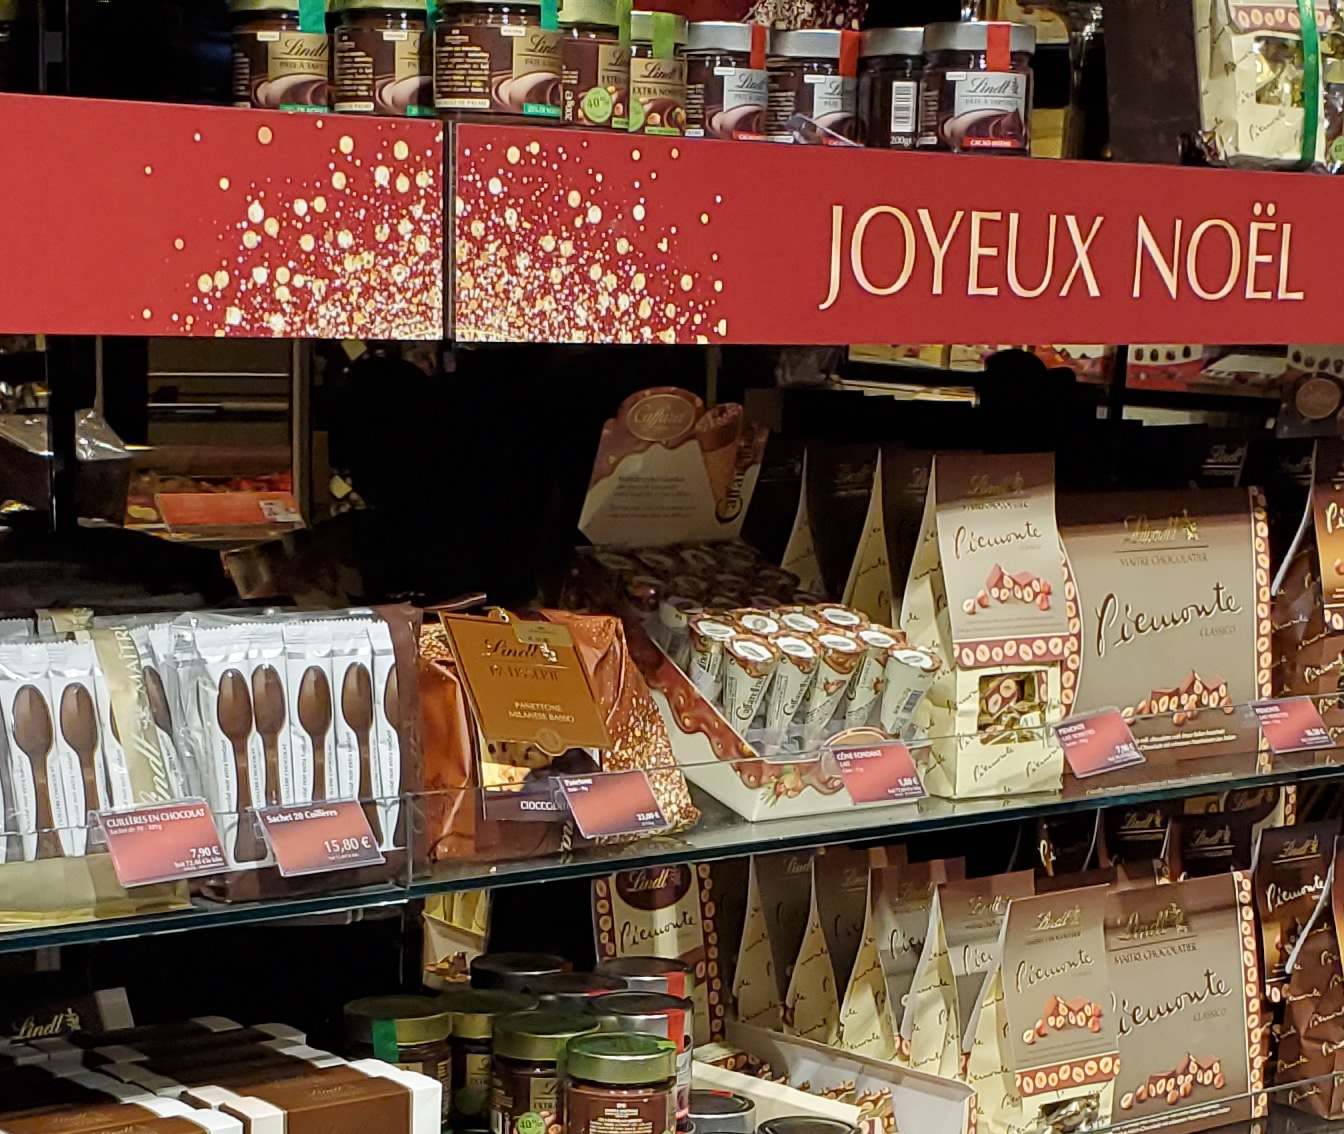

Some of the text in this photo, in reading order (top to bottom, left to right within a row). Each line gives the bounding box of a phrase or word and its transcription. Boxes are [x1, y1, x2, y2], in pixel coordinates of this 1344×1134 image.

[283, 37, 328, 57] Lindt
[643, 62, 681, 82] Lindt
[967, 73, 1013, 95] Lindt
[819, 201, 1304, 310] JOYEUX NOËL
[952, 519, 1044, 560] Piemonte
[1095, 582, 1243, 659] Piemonte
[106, 807, 206, 828] CUILLÈRES EN CHOCOLAT
[266, 813, 293, 825] Sachet
[293, 811, 304, 822] 20
[188, 846, 221, 860] 7,90 €
[324, 836, 373, 854] 15,80 €
[1264, 872, 1328, 912] Piemonte
[618, 911, 697, 955] Piemonte
[1015, 948, 1096, 995] Piemonte
[1111, 967, 1233, 1040] iemonte
[11, 1014, 66, 1041] Lindt
